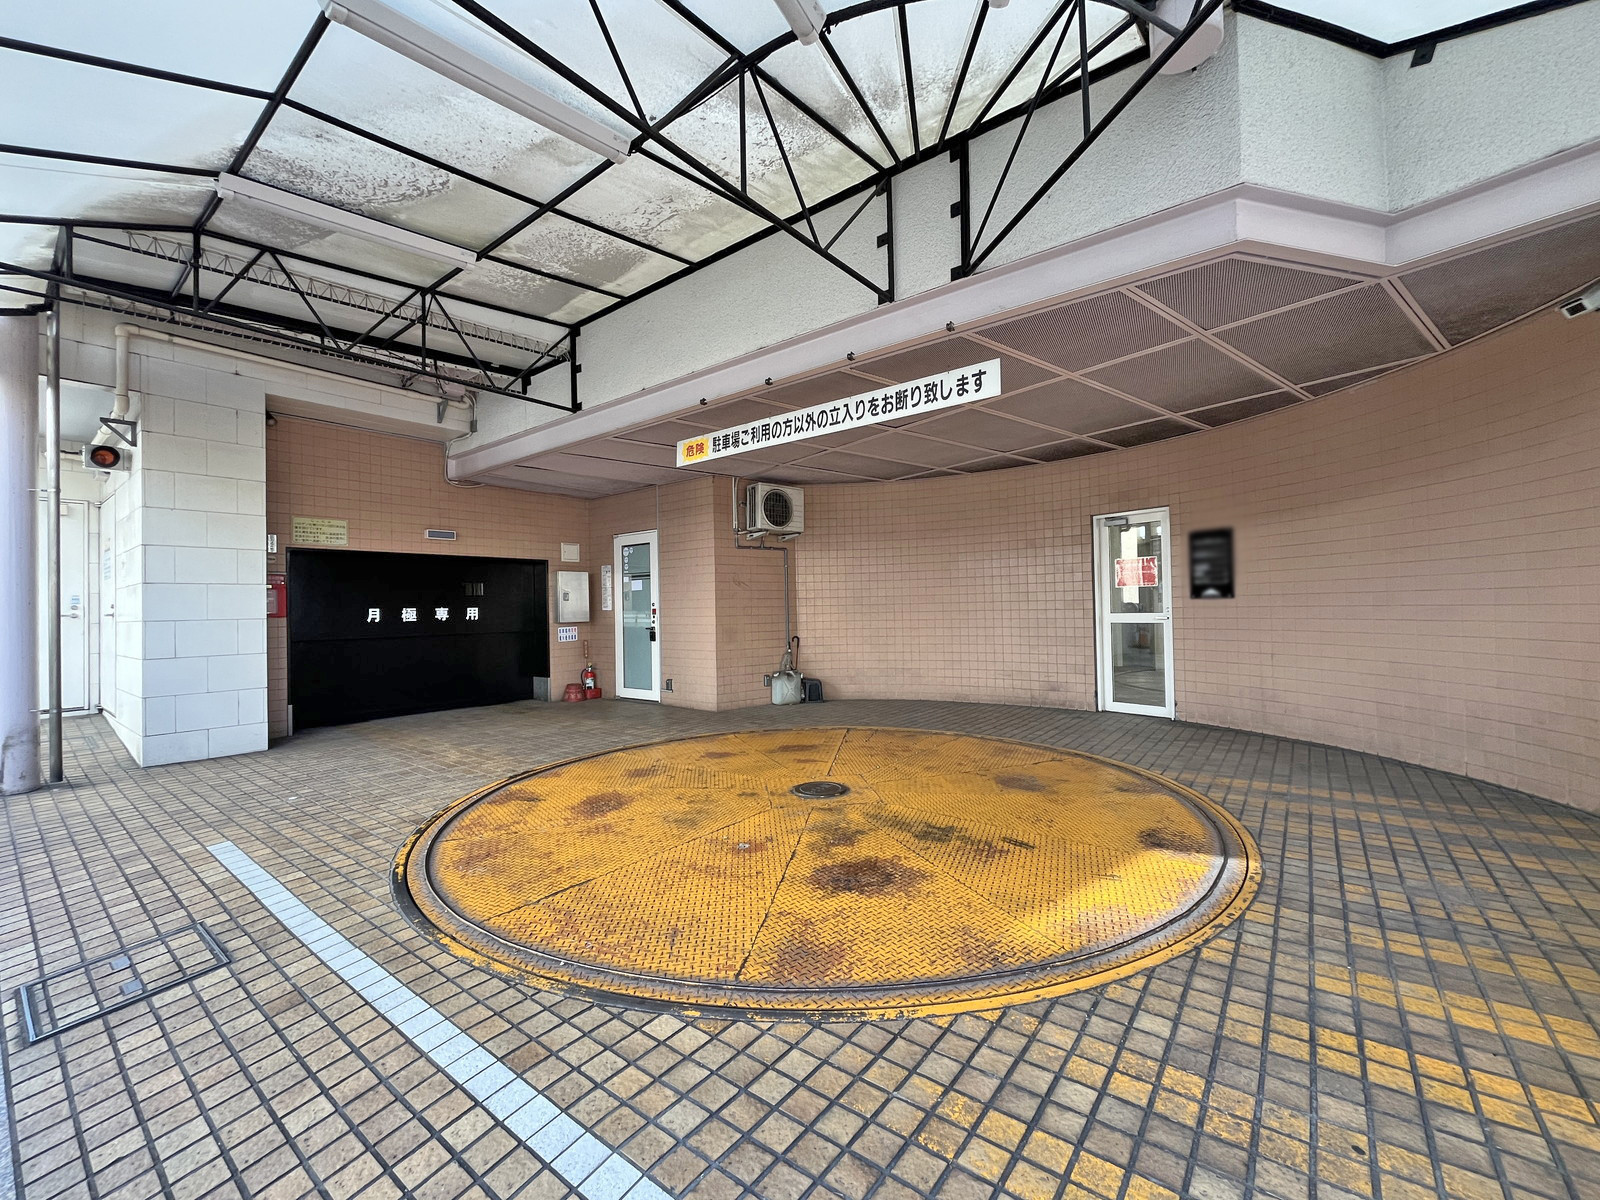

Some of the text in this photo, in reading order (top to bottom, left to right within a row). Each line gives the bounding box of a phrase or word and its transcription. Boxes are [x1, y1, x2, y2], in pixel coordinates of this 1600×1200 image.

[685, 369, 987, 458] 危険 駐車場ご利用の方以外の立入りをお断り致します
[366, 607, 479, 622] 月極専用
